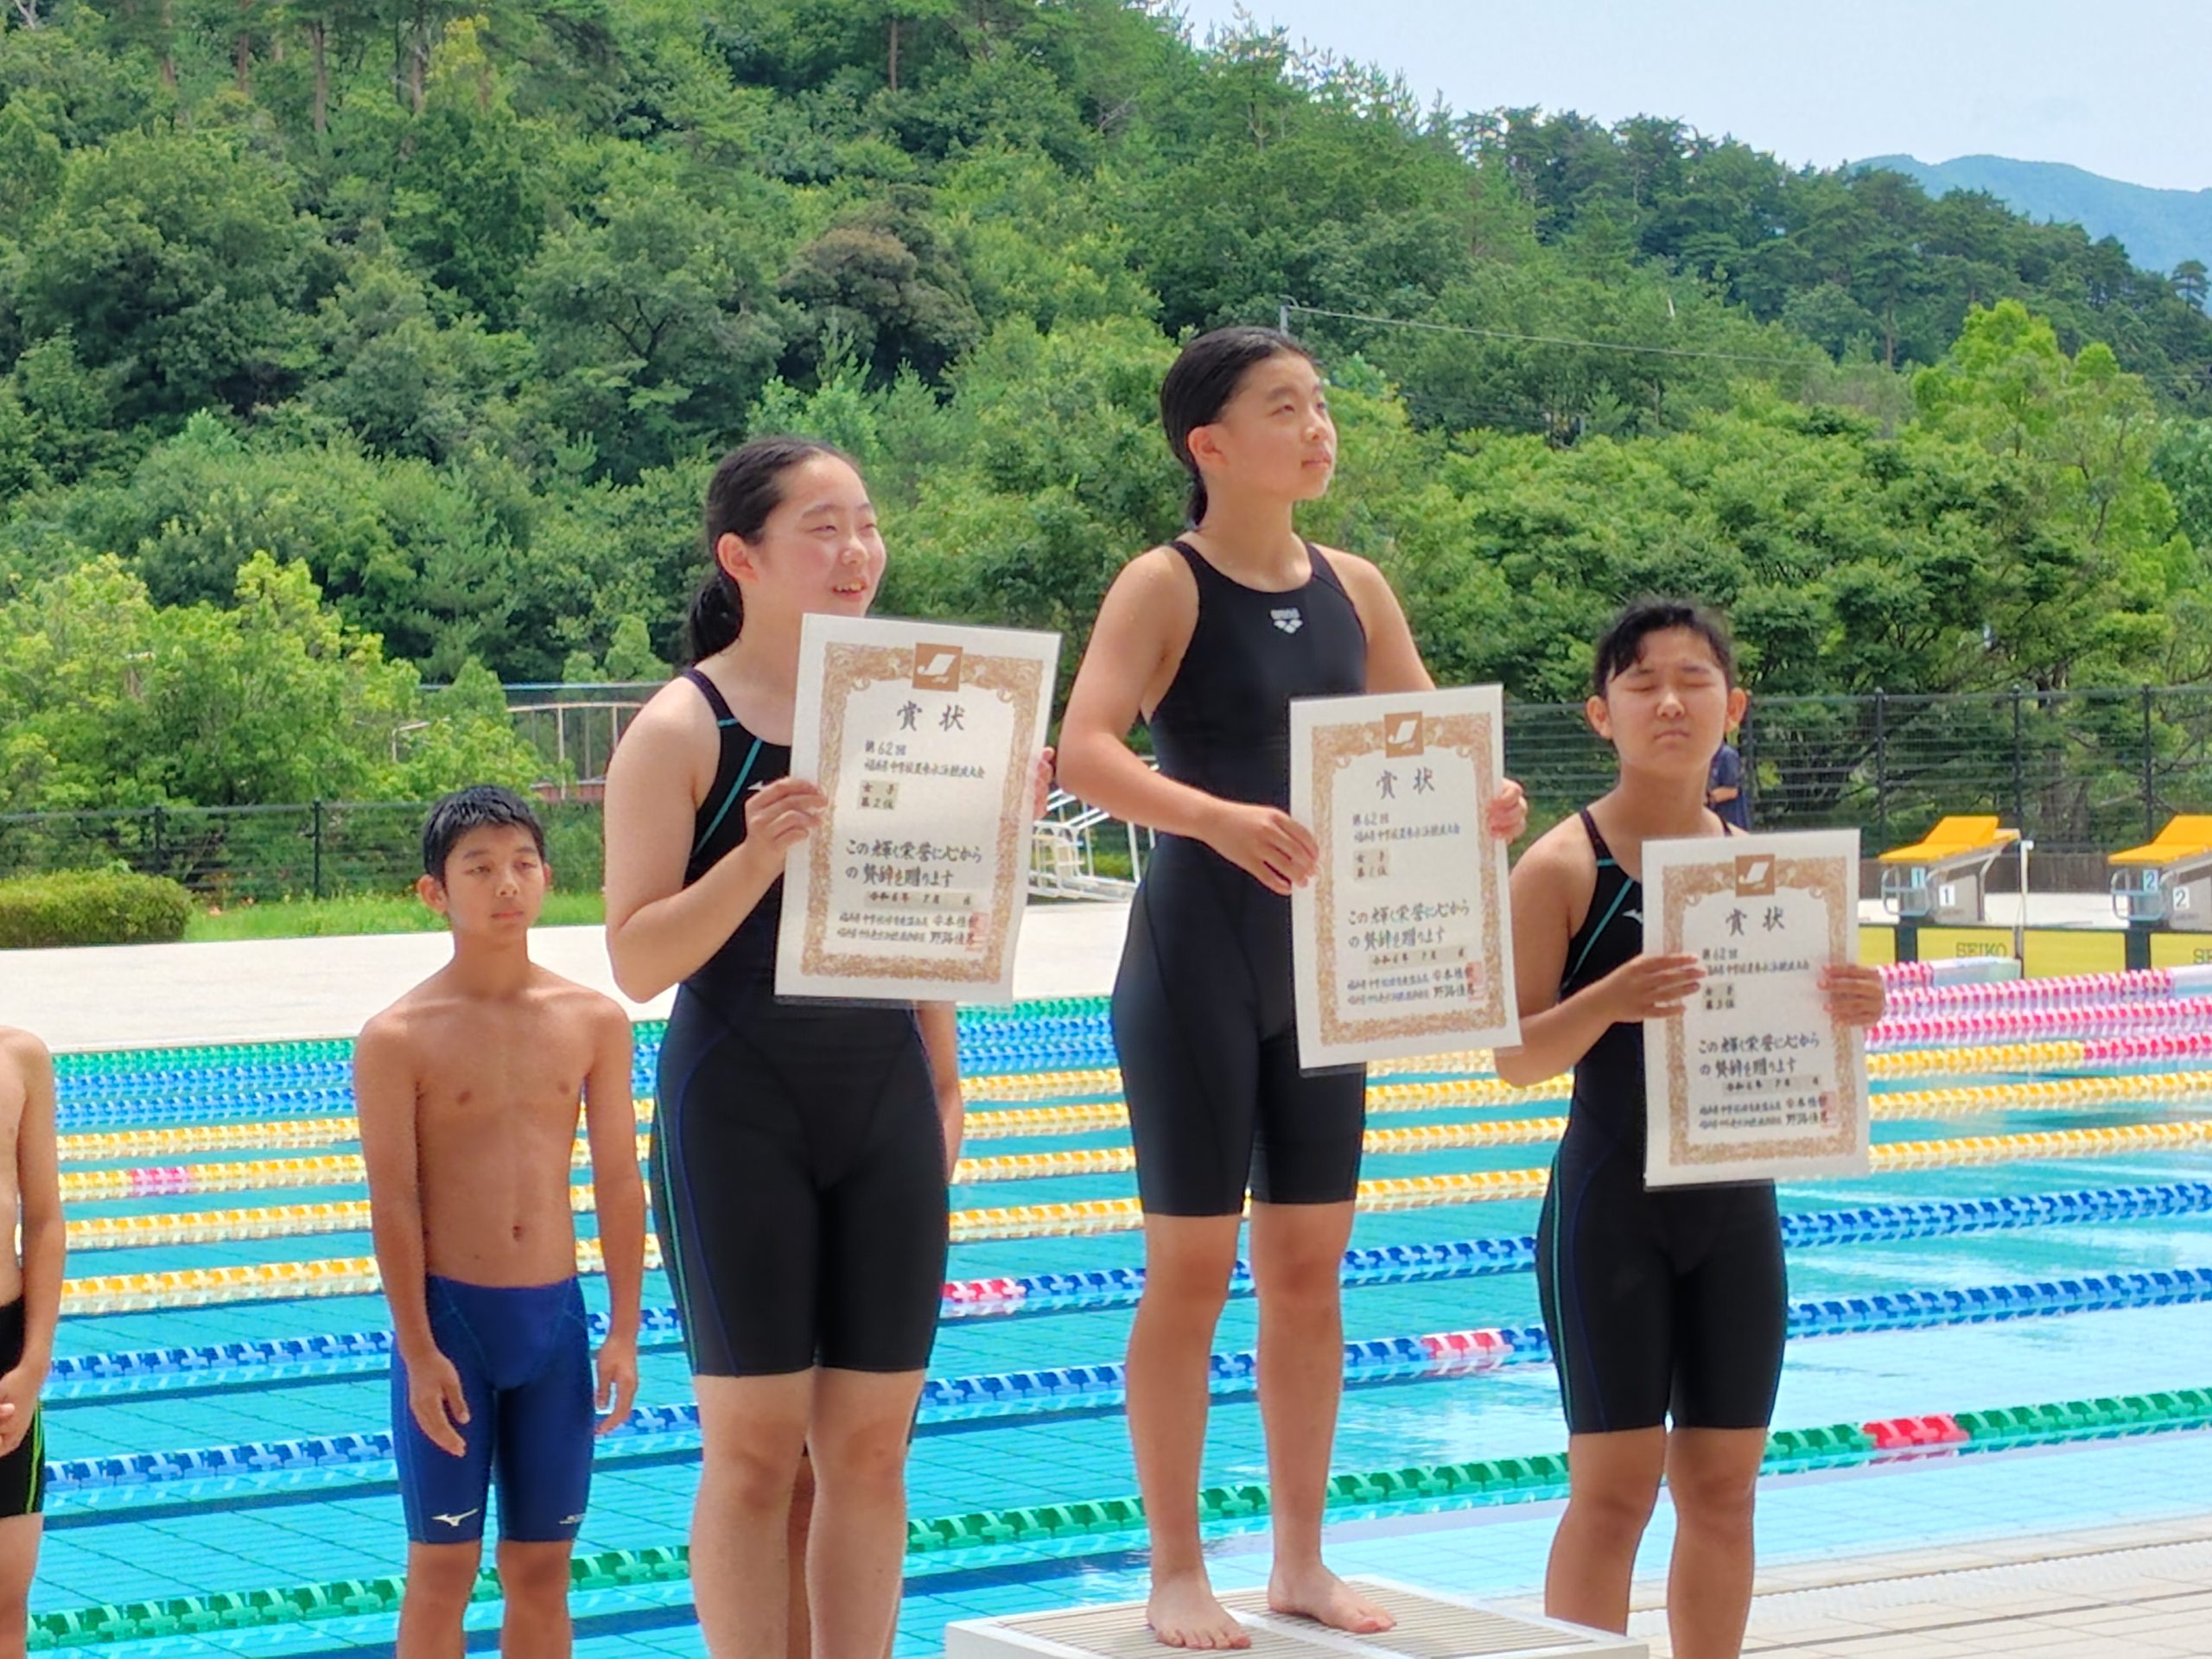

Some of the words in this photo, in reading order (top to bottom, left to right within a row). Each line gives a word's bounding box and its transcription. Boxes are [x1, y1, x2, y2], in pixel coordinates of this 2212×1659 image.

[897, 701, 965, 731] 賞状
[865, 740, 906, 756] 第62回
[1376, 766, 1434, 799] 賞状
[2145, 871, 2156, 891] 2
[2175, 888, 2187, 909] 2
[1726, 906, 1784, 936] 賞状
[1955, 942, 2007, 957] SEIKO
